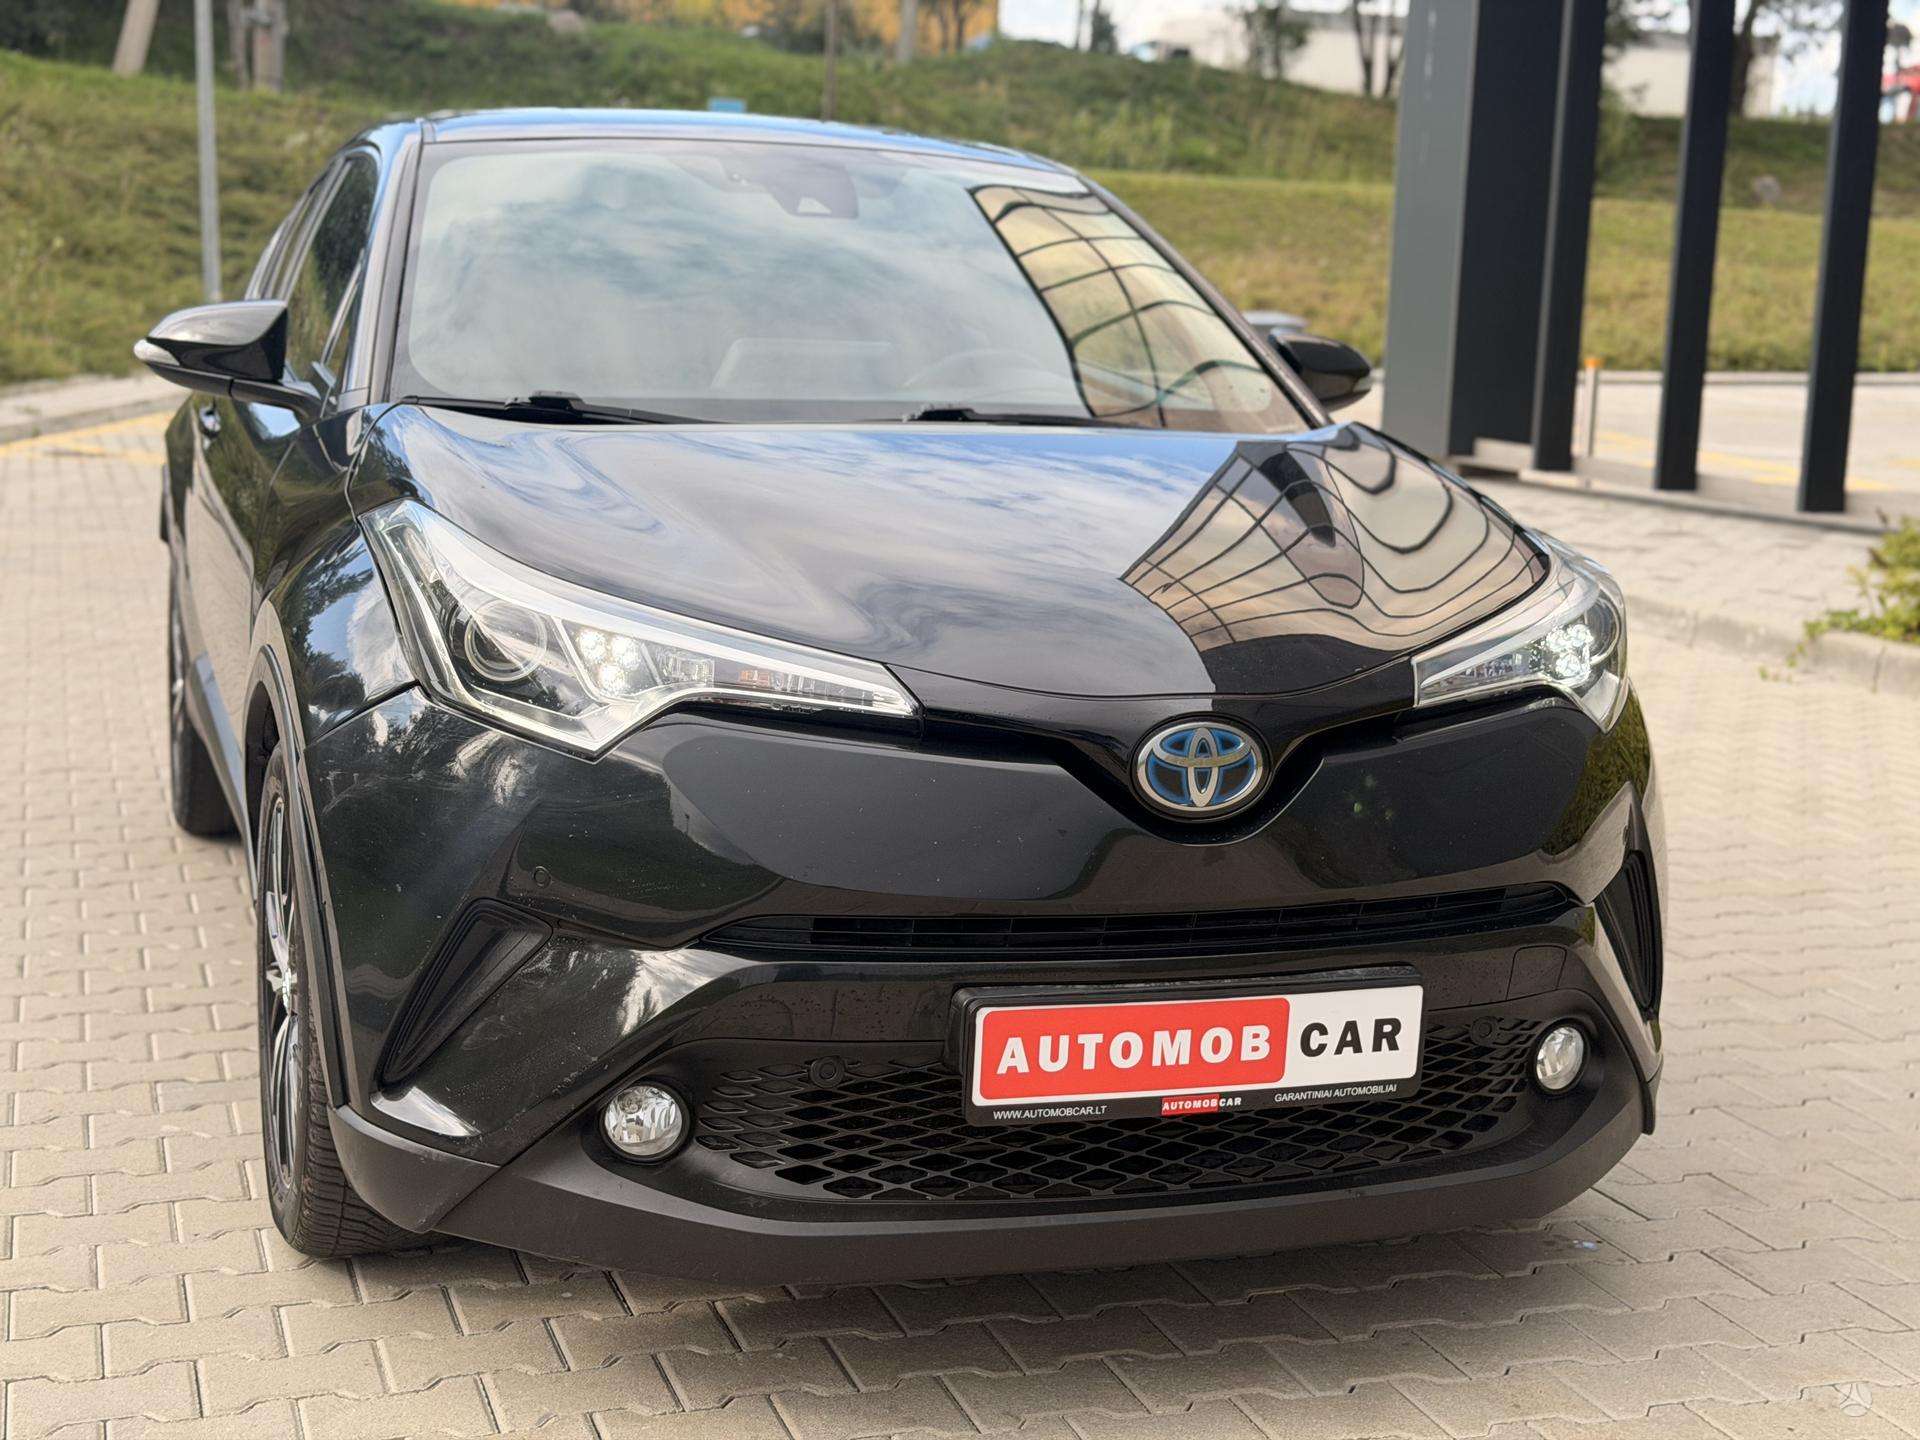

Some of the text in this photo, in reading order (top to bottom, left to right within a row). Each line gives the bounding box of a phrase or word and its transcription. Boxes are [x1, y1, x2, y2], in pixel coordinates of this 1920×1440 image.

[997, 1017, 1402, 1075] AUTOMOB CAR
[1274, 1083, 1397, 1103] GARANTINIAI AUTOMOBILIAI
[993, 1105, 1107, 1119] WWW.AUTOMOBCAR.LT
